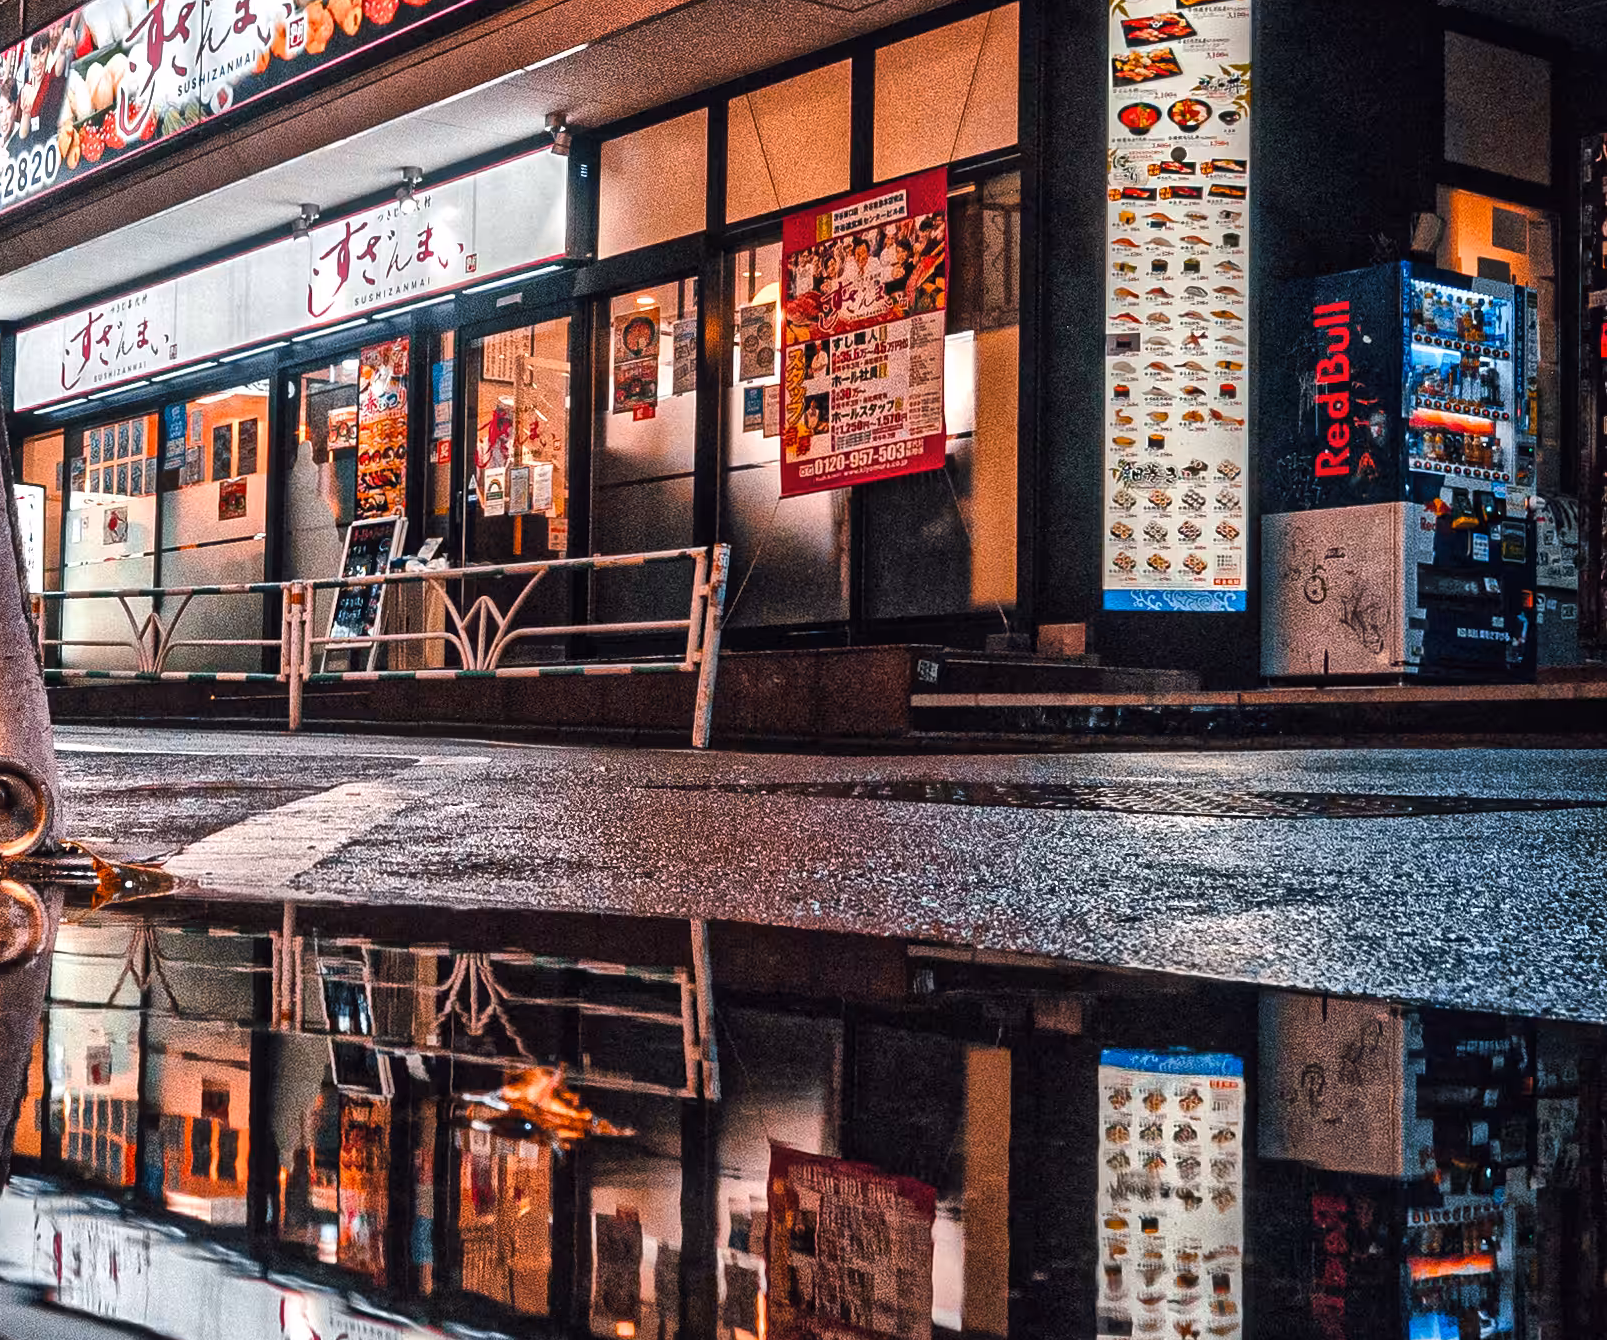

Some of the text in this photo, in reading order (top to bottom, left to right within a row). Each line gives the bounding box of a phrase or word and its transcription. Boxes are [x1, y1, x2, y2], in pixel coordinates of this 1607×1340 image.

[177, 49, 257, 97] SUSHIZANMAI
[354, 276, 431, 306] SUSHIZANMAI
[1313, 299, 1350, 477] Red Bull
[814, 441, 906, 475] 0120-957-503
